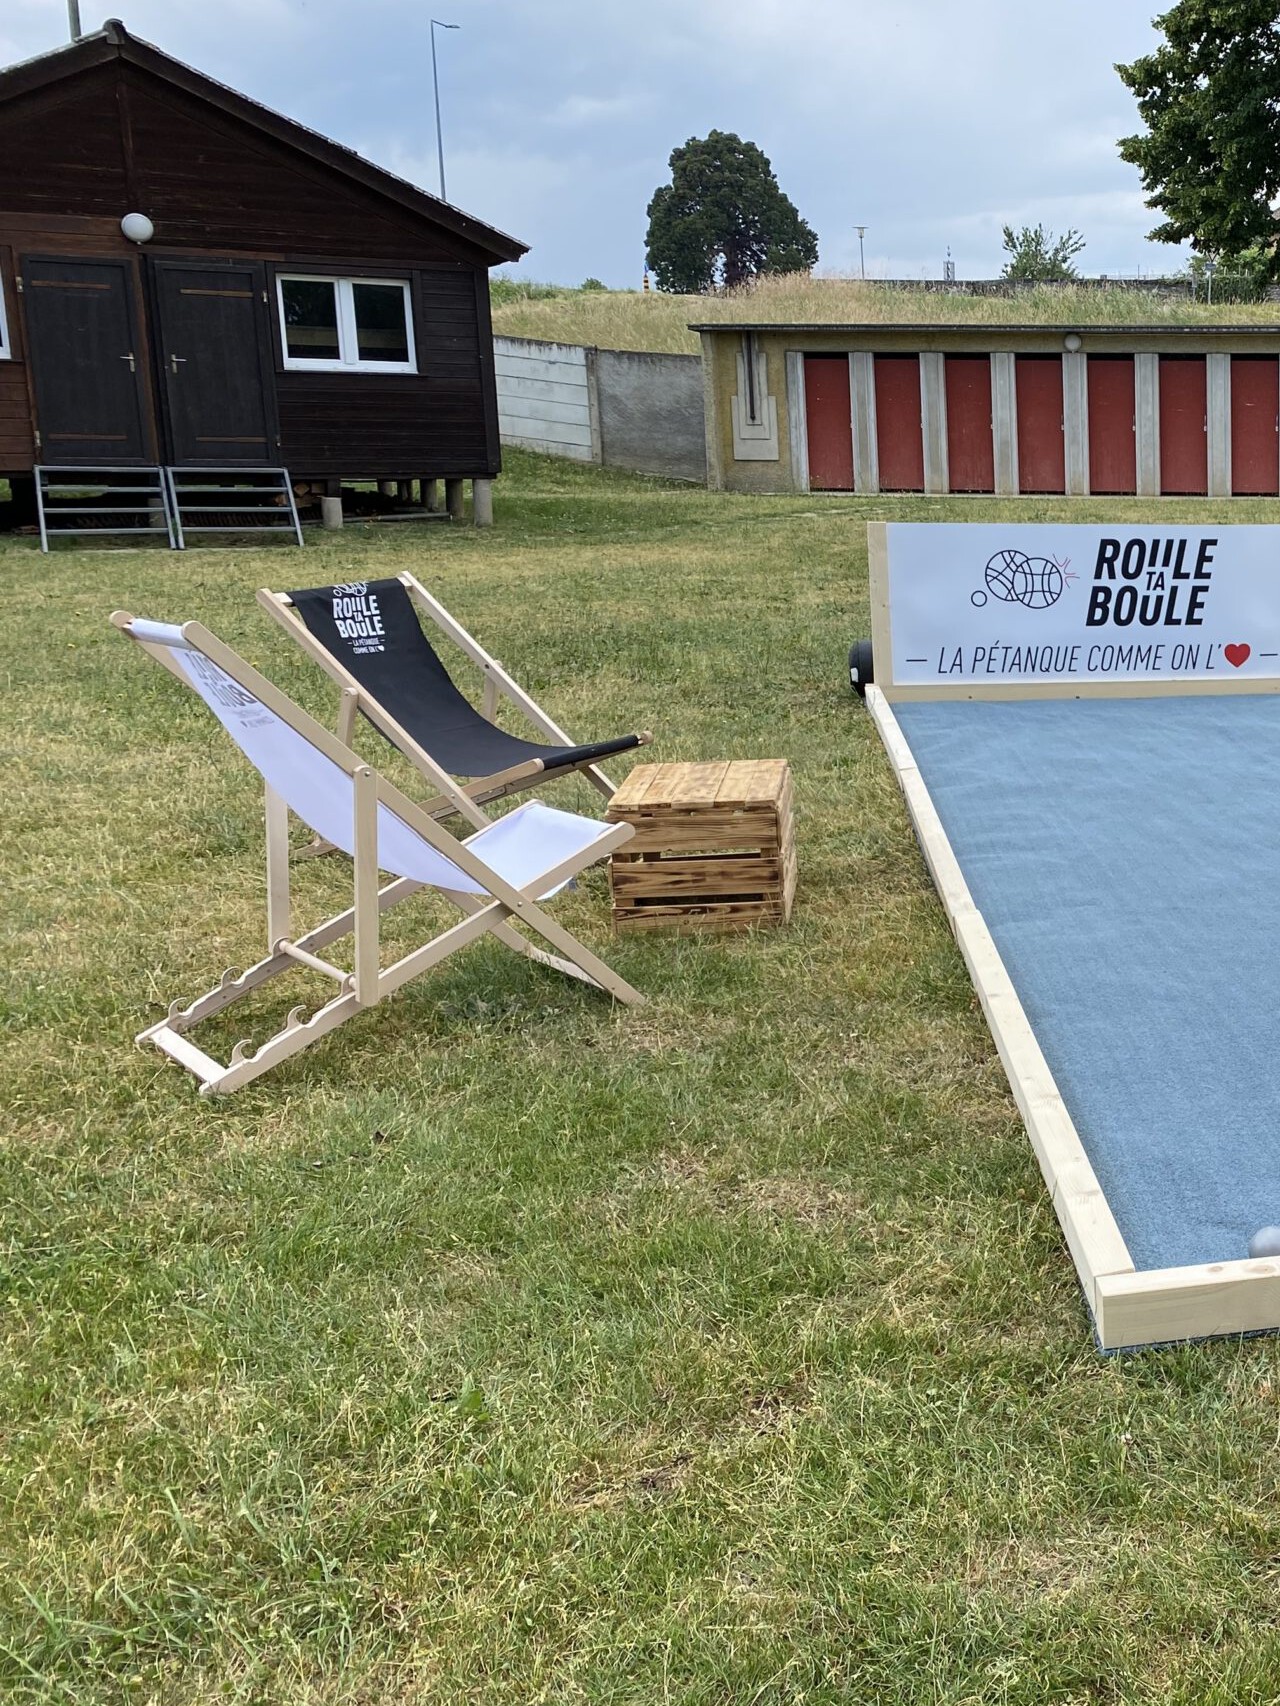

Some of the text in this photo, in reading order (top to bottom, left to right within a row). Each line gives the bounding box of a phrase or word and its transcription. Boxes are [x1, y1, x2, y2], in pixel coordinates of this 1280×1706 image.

[1146, 571, 1165, 591] TA
[1086, 585, 1210, 627] BOULE
[335, 616, 385, 638] BOULE
[938, 646, 963, 674] LA
[971, 640, 1082, 673] PÉTANQUE
[1087, 644, 1166, 672] COMME
[1171, 644, 1200, 671] ON
